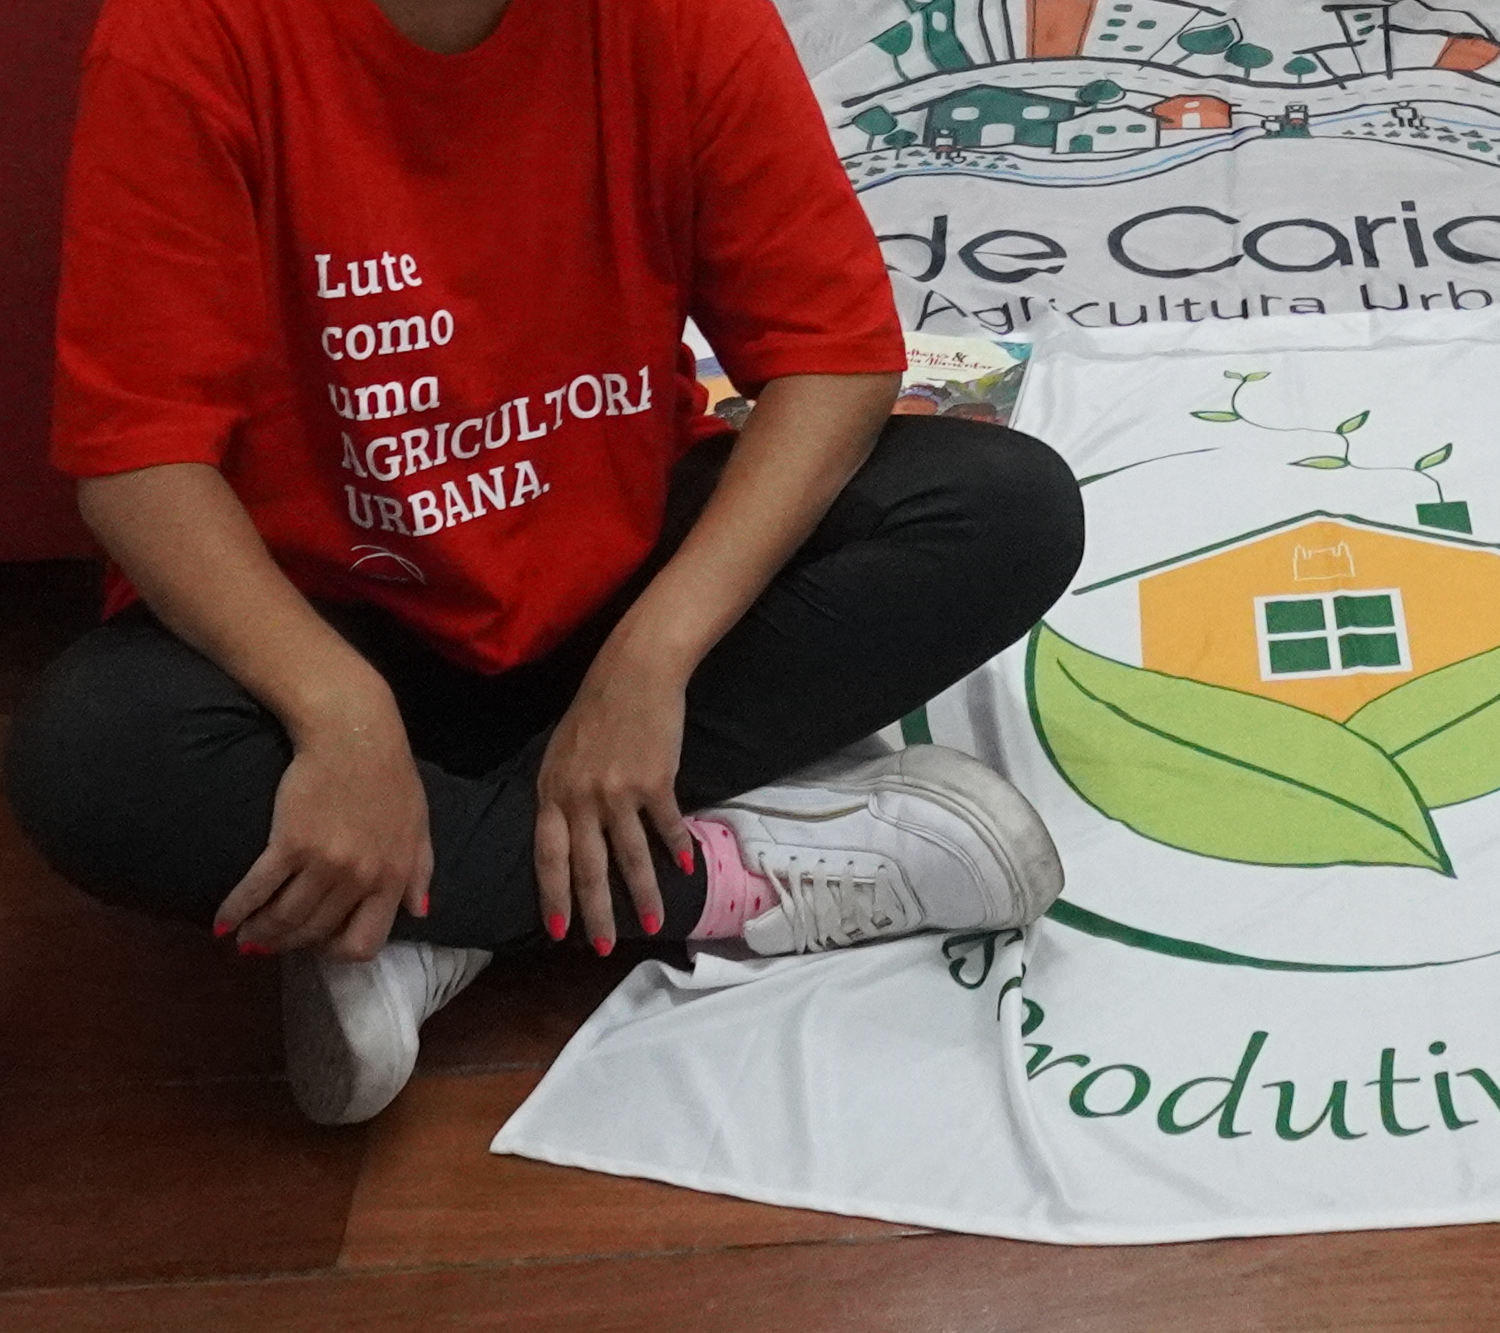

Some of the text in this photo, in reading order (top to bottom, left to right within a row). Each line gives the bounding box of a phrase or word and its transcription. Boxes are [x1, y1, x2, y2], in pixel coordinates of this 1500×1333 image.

[314, 250, 423, 299] Lute
[321, 309, 454, 361] como
[327, 375, 440, 421] uma
[344, 459, 551, 537] URBANA.
